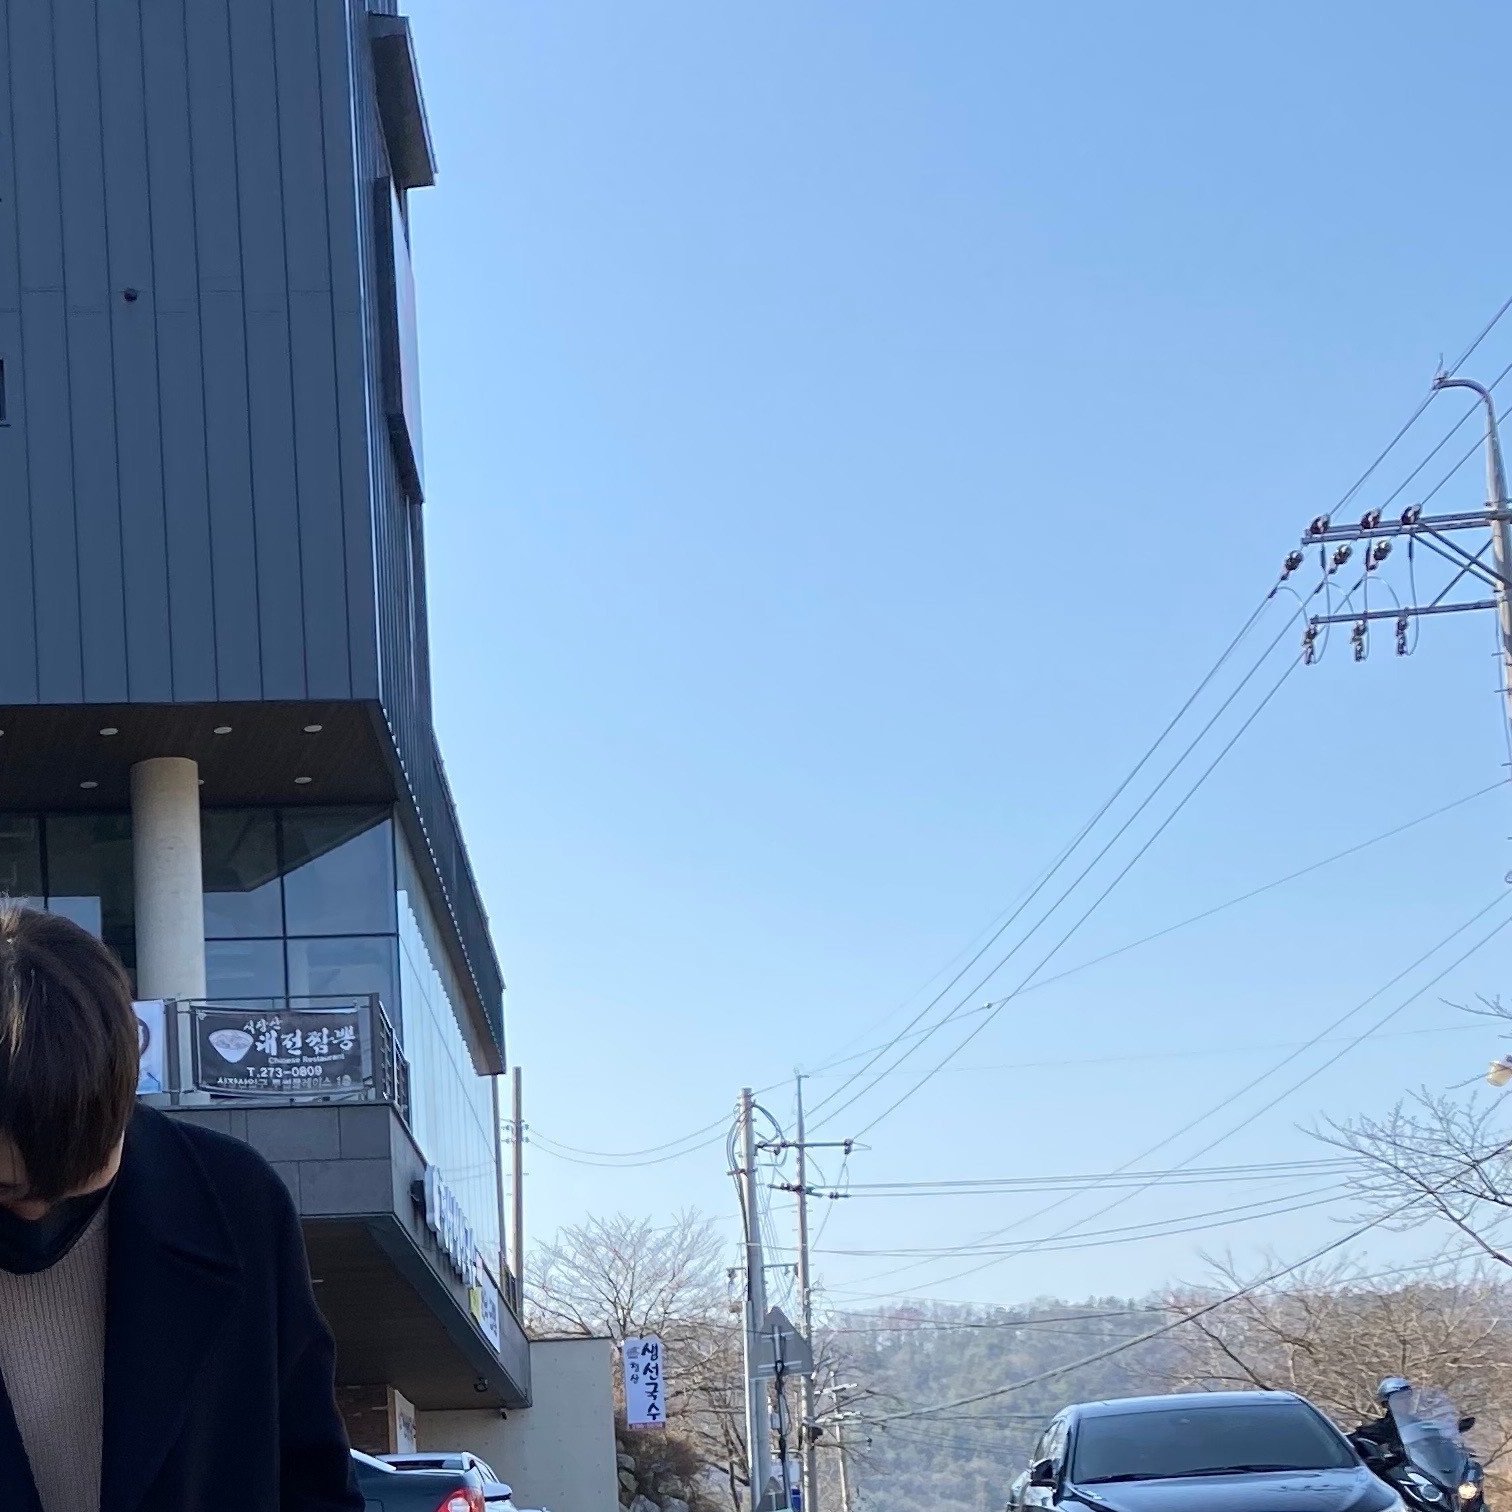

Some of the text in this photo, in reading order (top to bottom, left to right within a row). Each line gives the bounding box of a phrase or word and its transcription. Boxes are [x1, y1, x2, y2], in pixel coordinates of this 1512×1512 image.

[268, 1053, 345, 1064] Chinese Restaurant
[246, 1065, 323, 1078] T.273-0809
[641, 1342, 661, 1421] 생선국수
